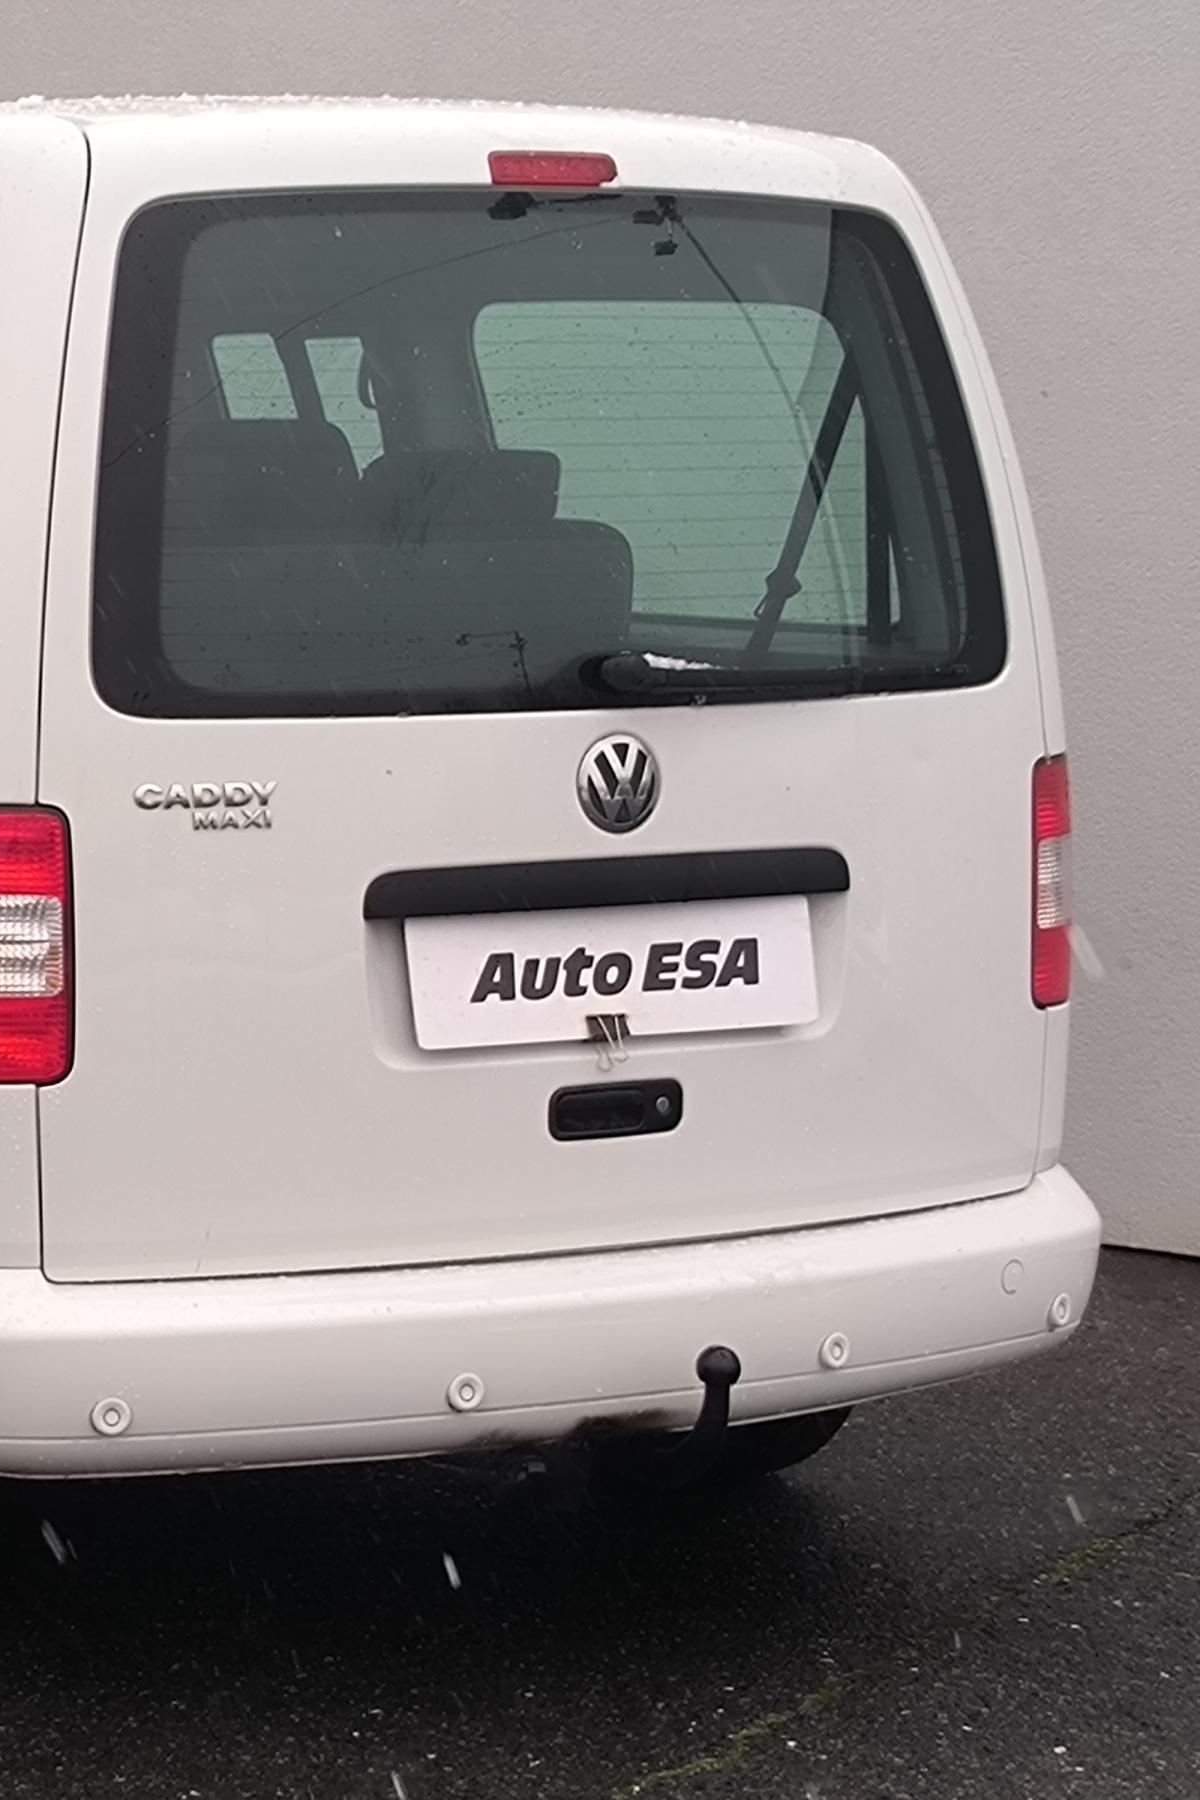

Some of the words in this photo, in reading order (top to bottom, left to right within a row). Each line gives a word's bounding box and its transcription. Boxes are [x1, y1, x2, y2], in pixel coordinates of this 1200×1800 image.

[133, 780, 278, 810] CADDY
[192, 809, 273, 831] MAXI
[470, 947, 633, 1003] Auto
[642, 937, 760, 992] ESA
